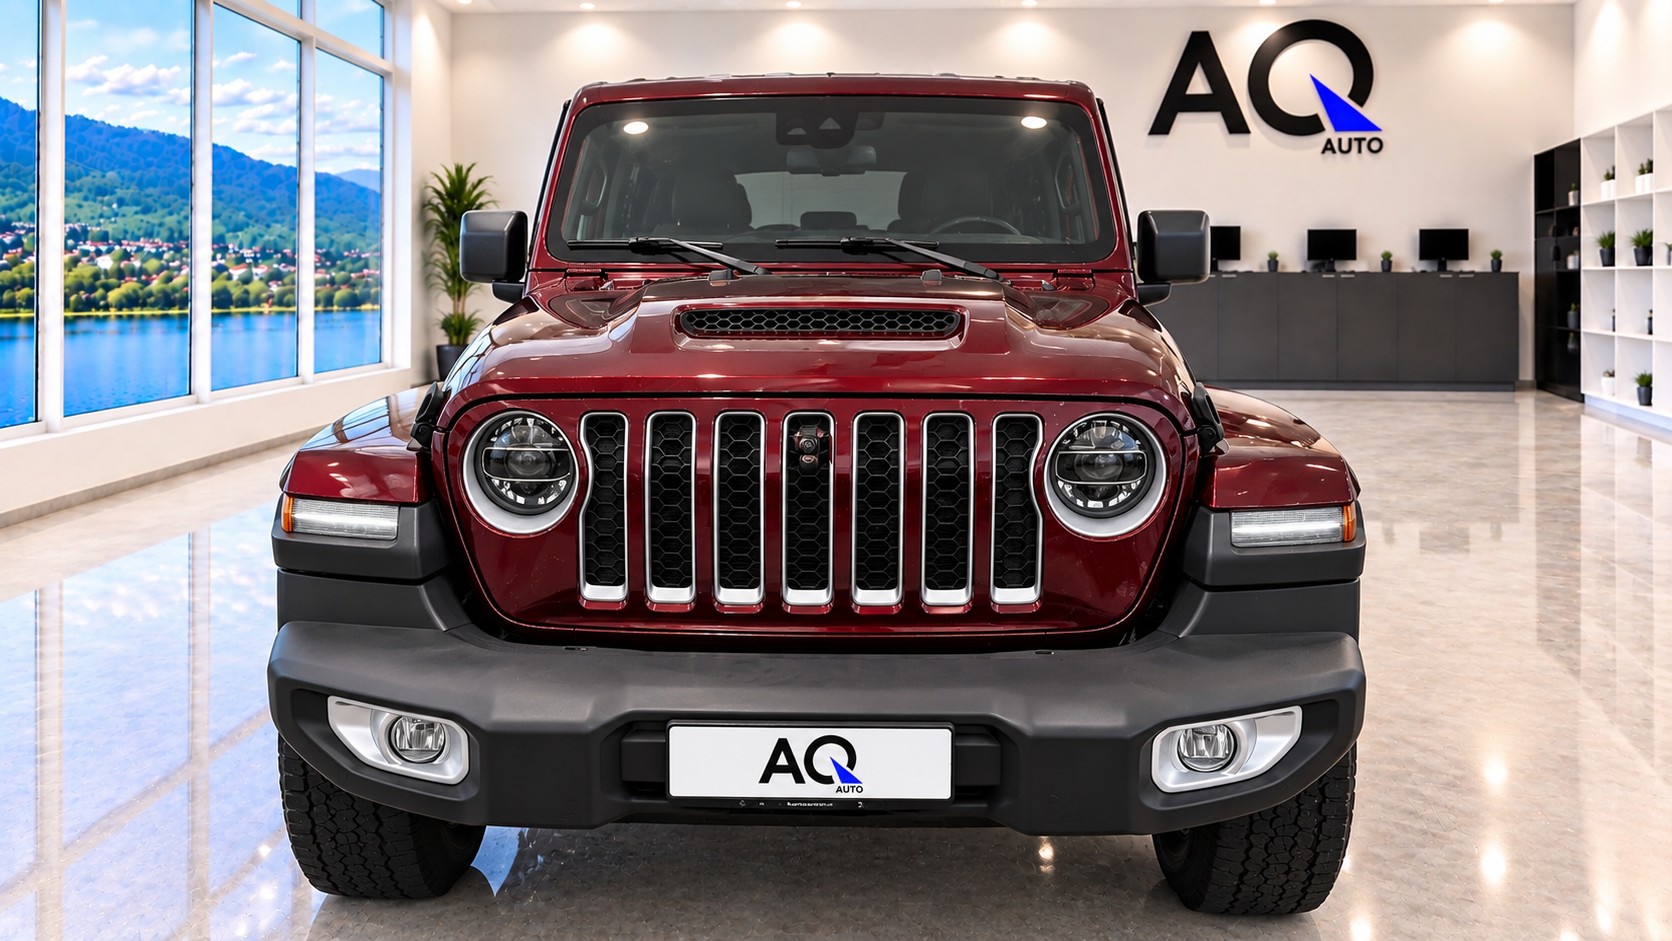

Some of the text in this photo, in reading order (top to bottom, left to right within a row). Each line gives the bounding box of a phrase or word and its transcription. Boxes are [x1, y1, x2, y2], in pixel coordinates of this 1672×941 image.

[1148, 19, 1382, 136] AQ
[1321, 137, 1384, 154] AUTO
[758, 735, 863, 785] AQ
[835, 785, 864, 794] AUTO
